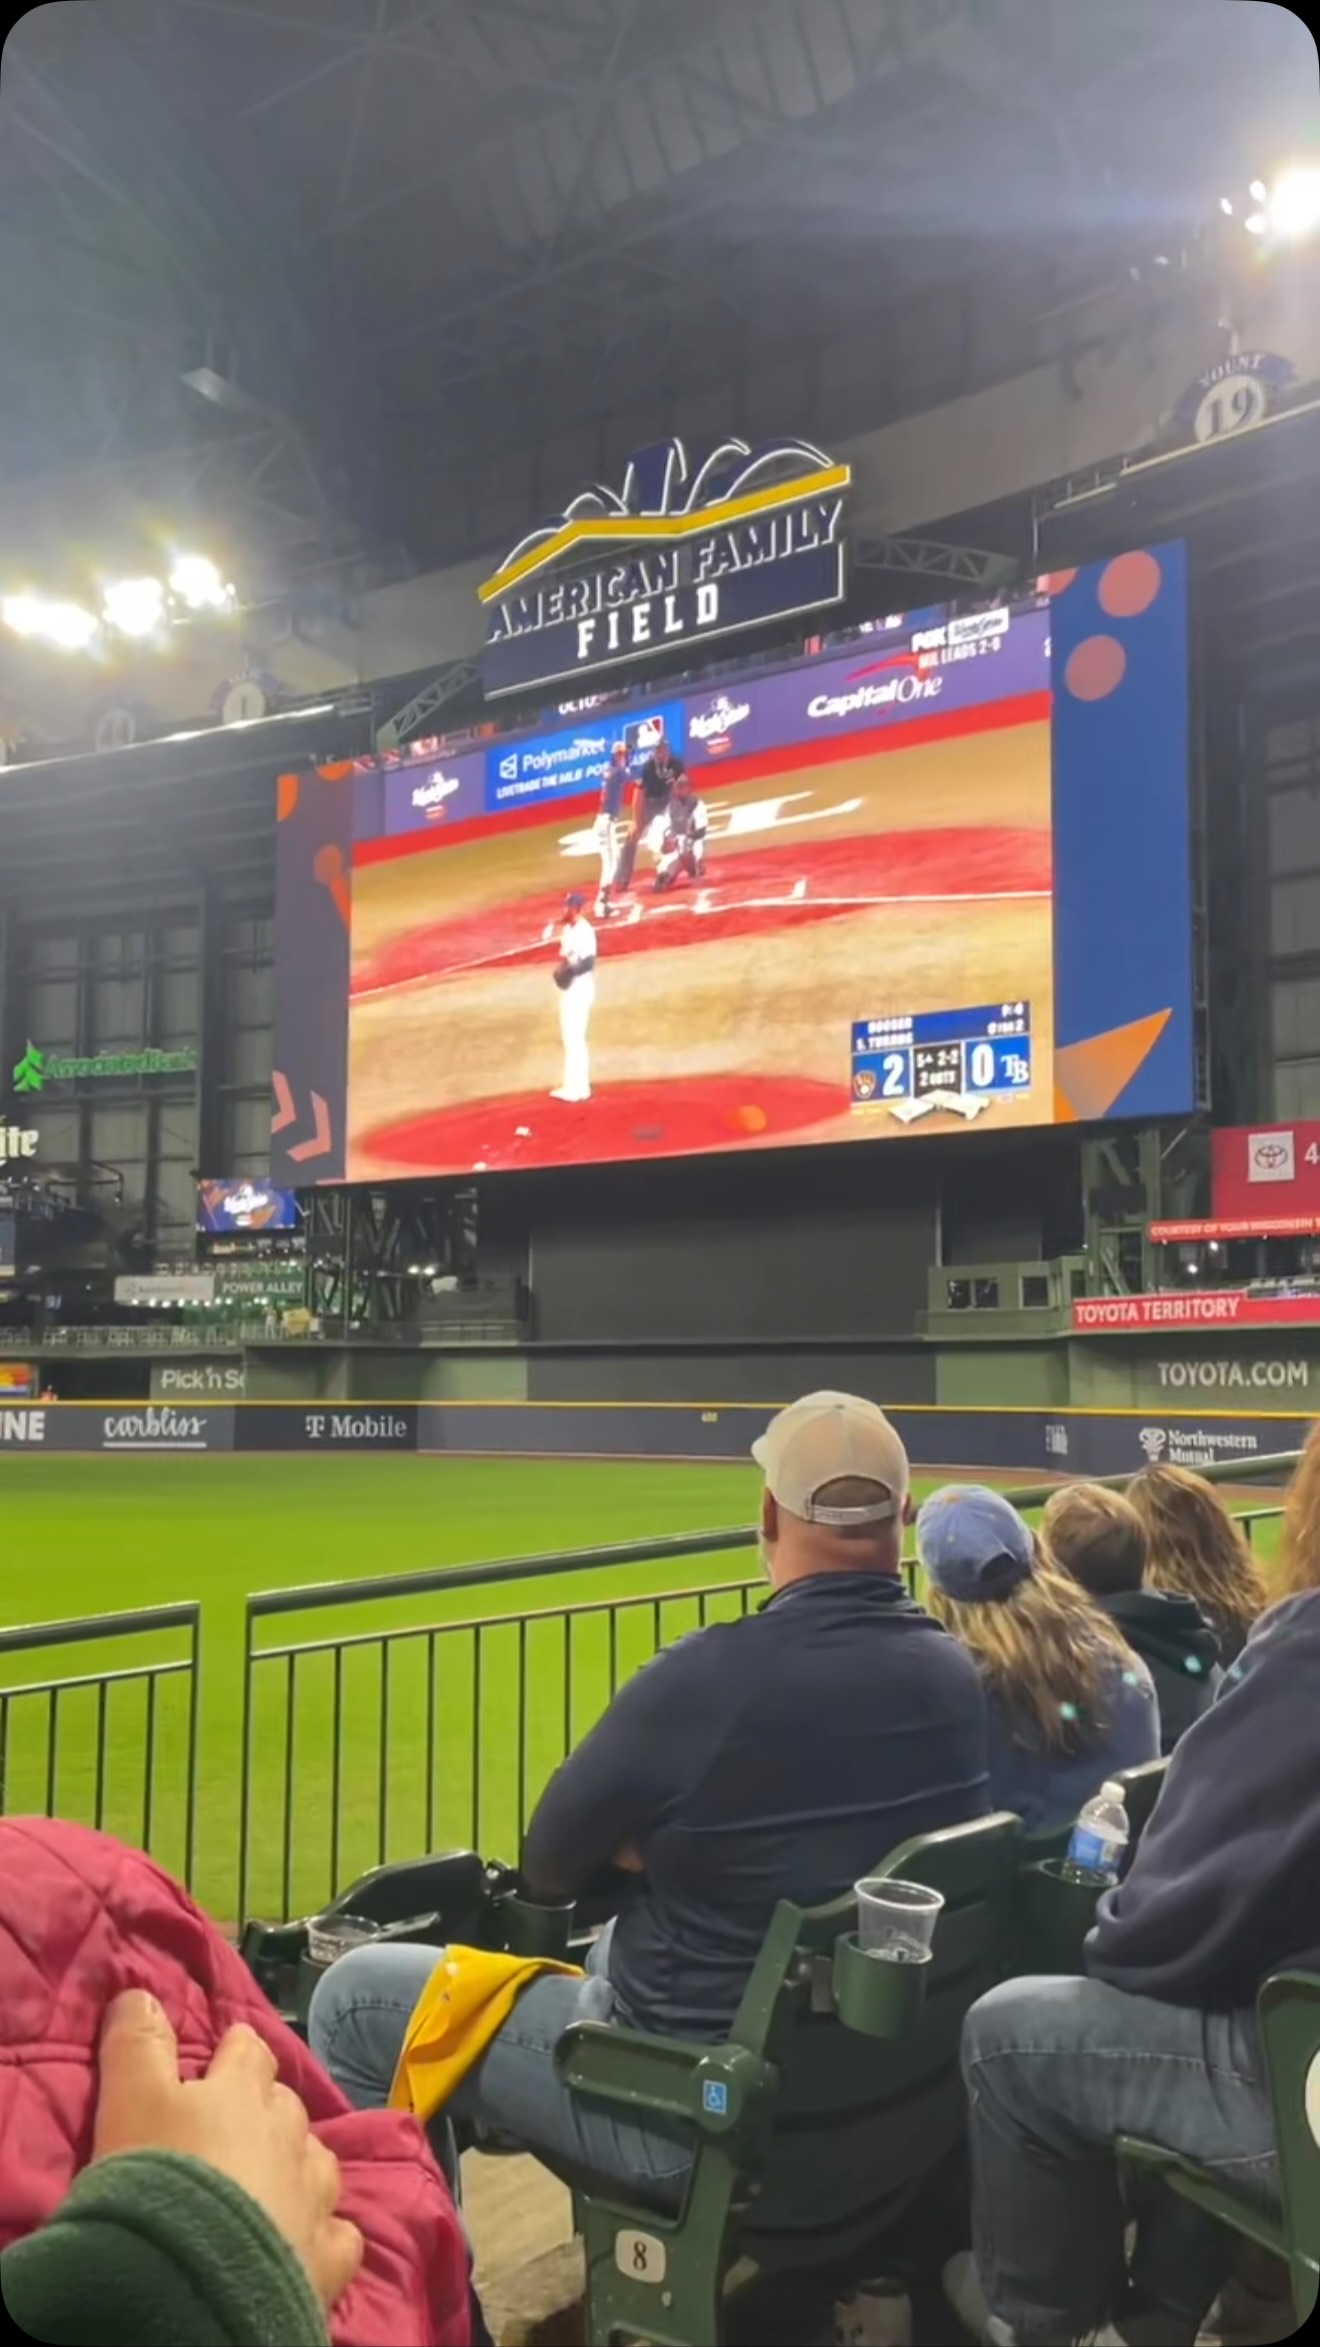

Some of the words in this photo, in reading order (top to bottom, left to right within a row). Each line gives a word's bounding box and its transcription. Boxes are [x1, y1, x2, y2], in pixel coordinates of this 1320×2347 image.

[1199, 354, 1265, 387] YOUNT
[1209, 386, 1254, 434] 19
[485, 550, 680, 645] AMERICAN
[692, 498, 844, 584] FAMILY
[577, 582, 719, 660] FIELD
[941, 641, 976, 665] LEADS
[807, 678, 897, 717] Capital
[897, 675, 943, 703] One
[882, 1053, 905, 1096] 2
[919, 1071, 928, 1087] 2
[971, 1043, 995, 1087] 0
[1000, 1053, 1029, 1084] TB
[0, 1114, 39, 1159] ite
[222, 1281, 265, 1294] POWER
[266, 1280, 303, 1294] ALLEY
[1076, 1303, 1139, 1323] TOYOTA
[1142, 1296, 1241, 1321] TERRITORY
[161, 1368, 203, 1389] Pick
[1157, 1360, 1310, 1387] TOYOTA.COM
[104, 1406, 208, 1438] carbliss
[330, 1414, 408, 1438] Mobile
[1168, 1429, 1258, 1449] Northwestern
[1168, 1447, 1215, 1465] Mutual
[632, 2240, 648, 2272] 8
